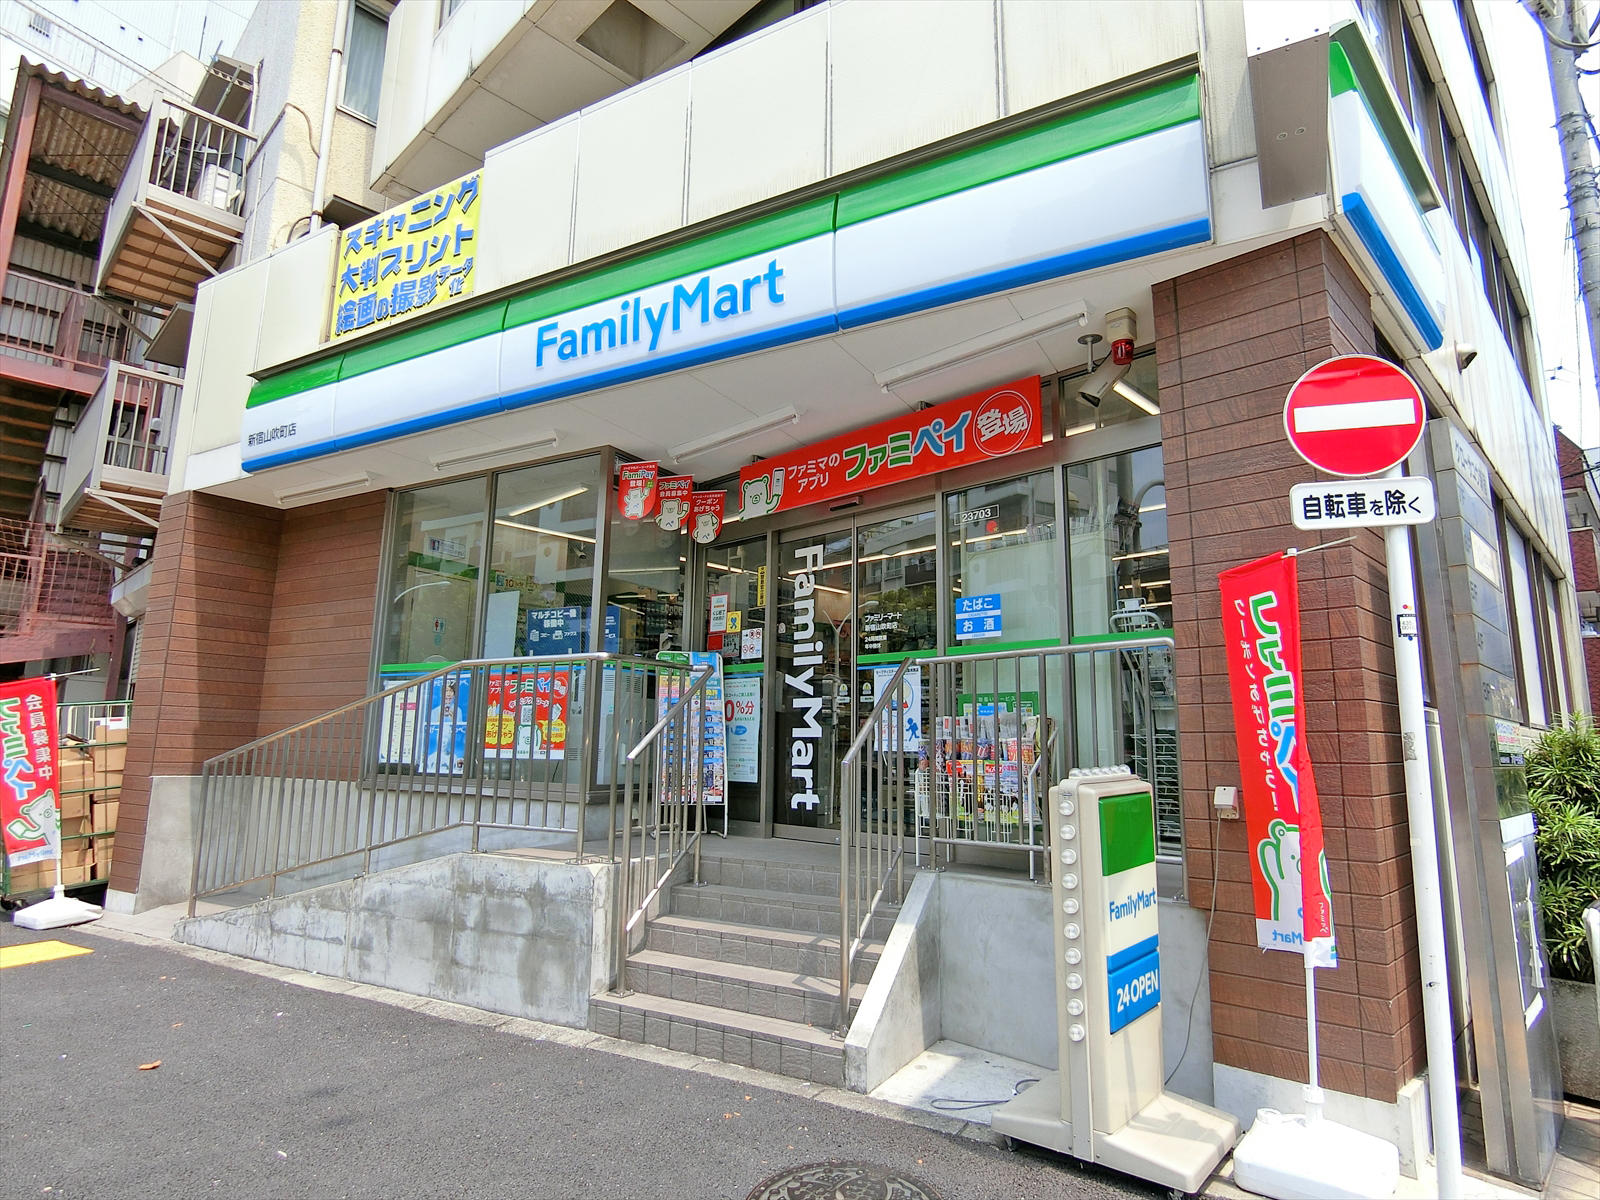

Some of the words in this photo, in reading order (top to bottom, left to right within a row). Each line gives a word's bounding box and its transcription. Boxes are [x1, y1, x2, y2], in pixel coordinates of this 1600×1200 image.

[335, 270, 439, 336] 絵画の撮影
[536, 258, 785, 368] FamilyMart
[248, 422, 296, 447] 新宿山吹町店
[976, 405, 1028, 443] 登場
[842, 410, 973, 482] ファミペイ
[787, 453, 840, 480] ファミマの
[798, 473, 830, 494] アプリ
[961, 508, 992, 522] 23703
[1302, 488, 1423, 521] 自転車を除く
[865, 612, 903, 622] ファミリーマート
[962, 597, 994, 612] たばこ
[784, 543, 824, 812] FamilyMart
[1109, 887, 1157, 923] FamilyMart
